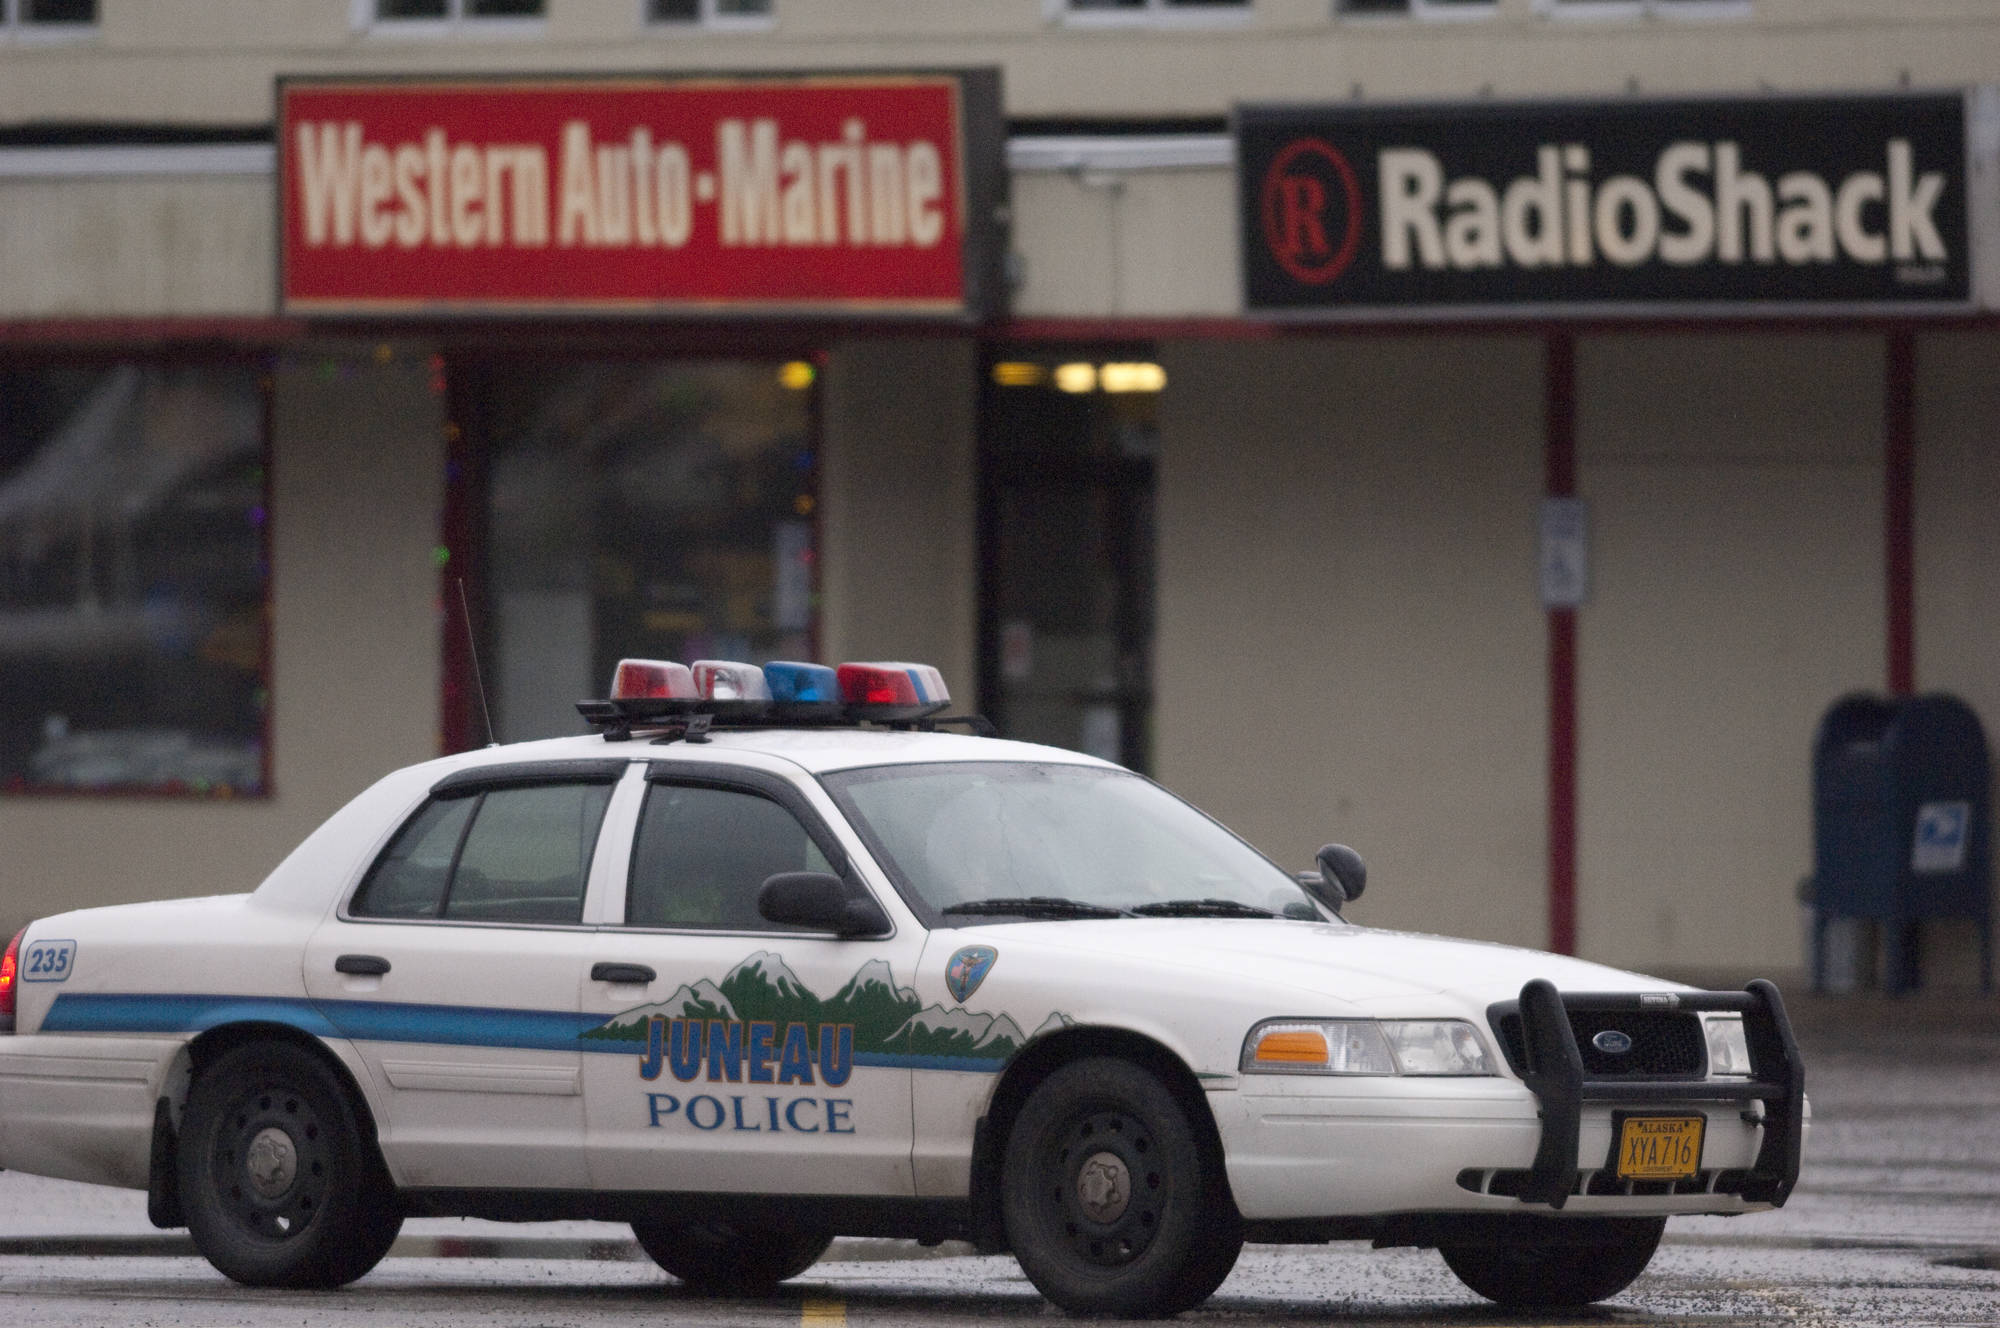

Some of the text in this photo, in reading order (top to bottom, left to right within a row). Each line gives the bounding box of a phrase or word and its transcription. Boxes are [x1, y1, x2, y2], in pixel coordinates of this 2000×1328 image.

[297, 120, 549, 248] Western
[1378, 139, 1949, 270] RadioShack
[30, 948, 69, 972] 235
[639, 1018, 854, 1087] JUNEAU
[645, 1093, 856, 1134] POLICE
[1641, 1123, 1683, 1133] ALASKA
